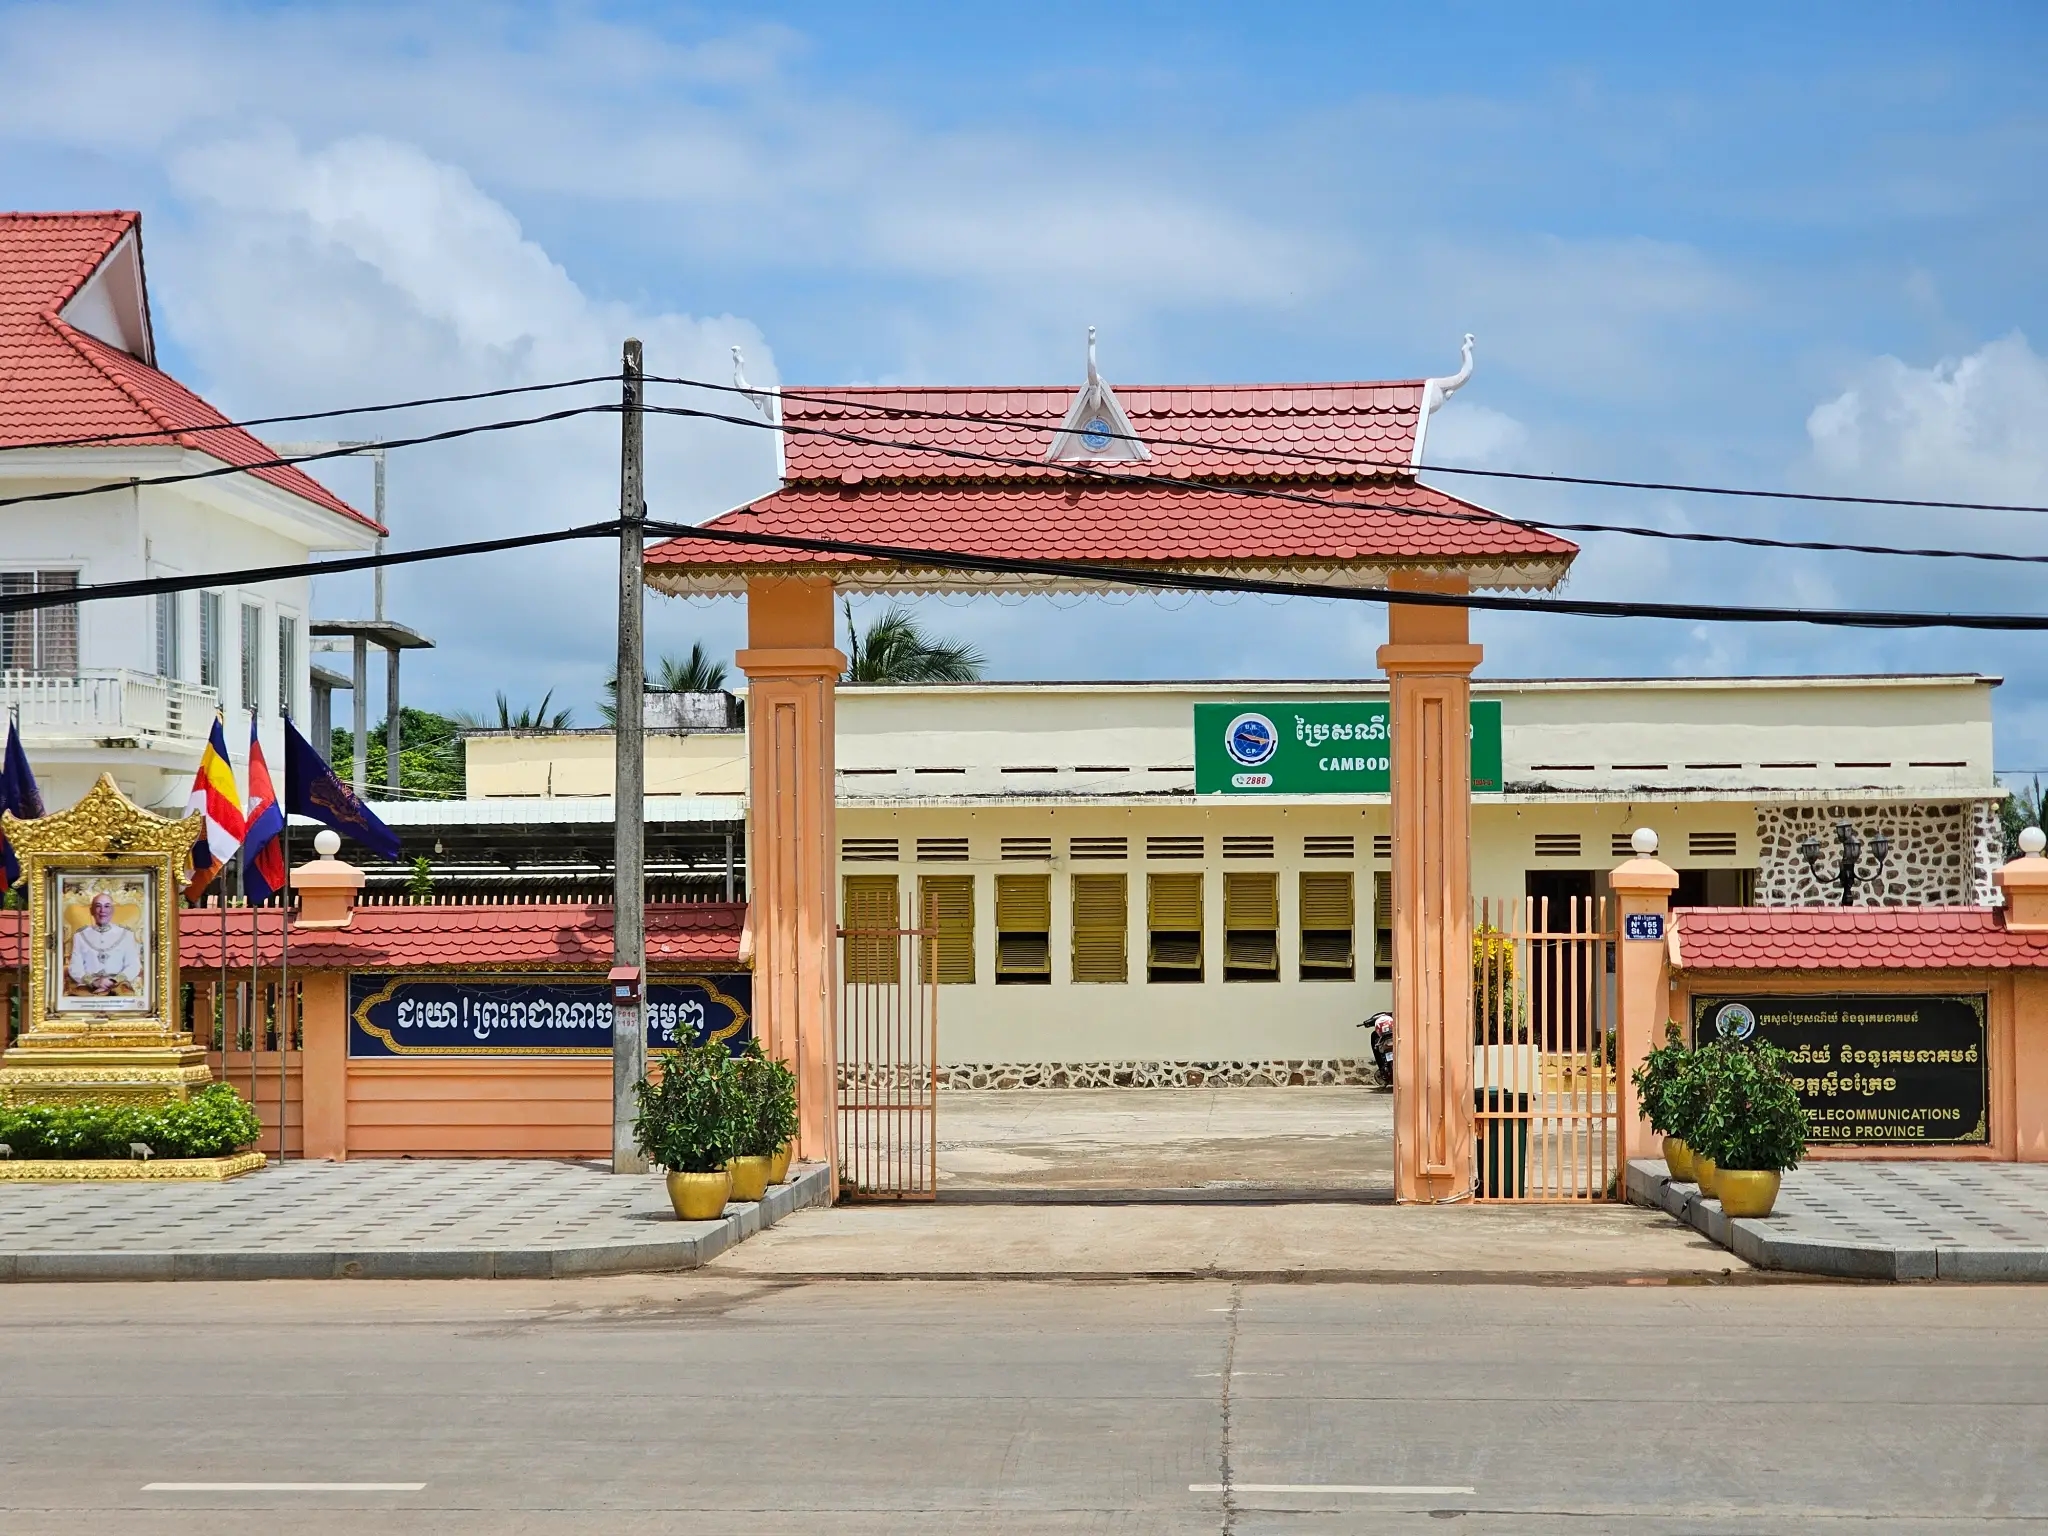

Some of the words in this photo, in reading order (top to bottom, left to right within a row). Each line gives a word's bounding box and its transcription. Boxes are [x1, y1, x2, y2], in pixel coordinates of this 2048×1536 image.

[1319, 757, 1392, 771] CAMBOD
[1246, 776, 1267, 785] 2888
[1802, 1108, 1961, 1121] TELECOMMUNICATIONS
[1855, 1125, 1925, 1138] PROVINCE
